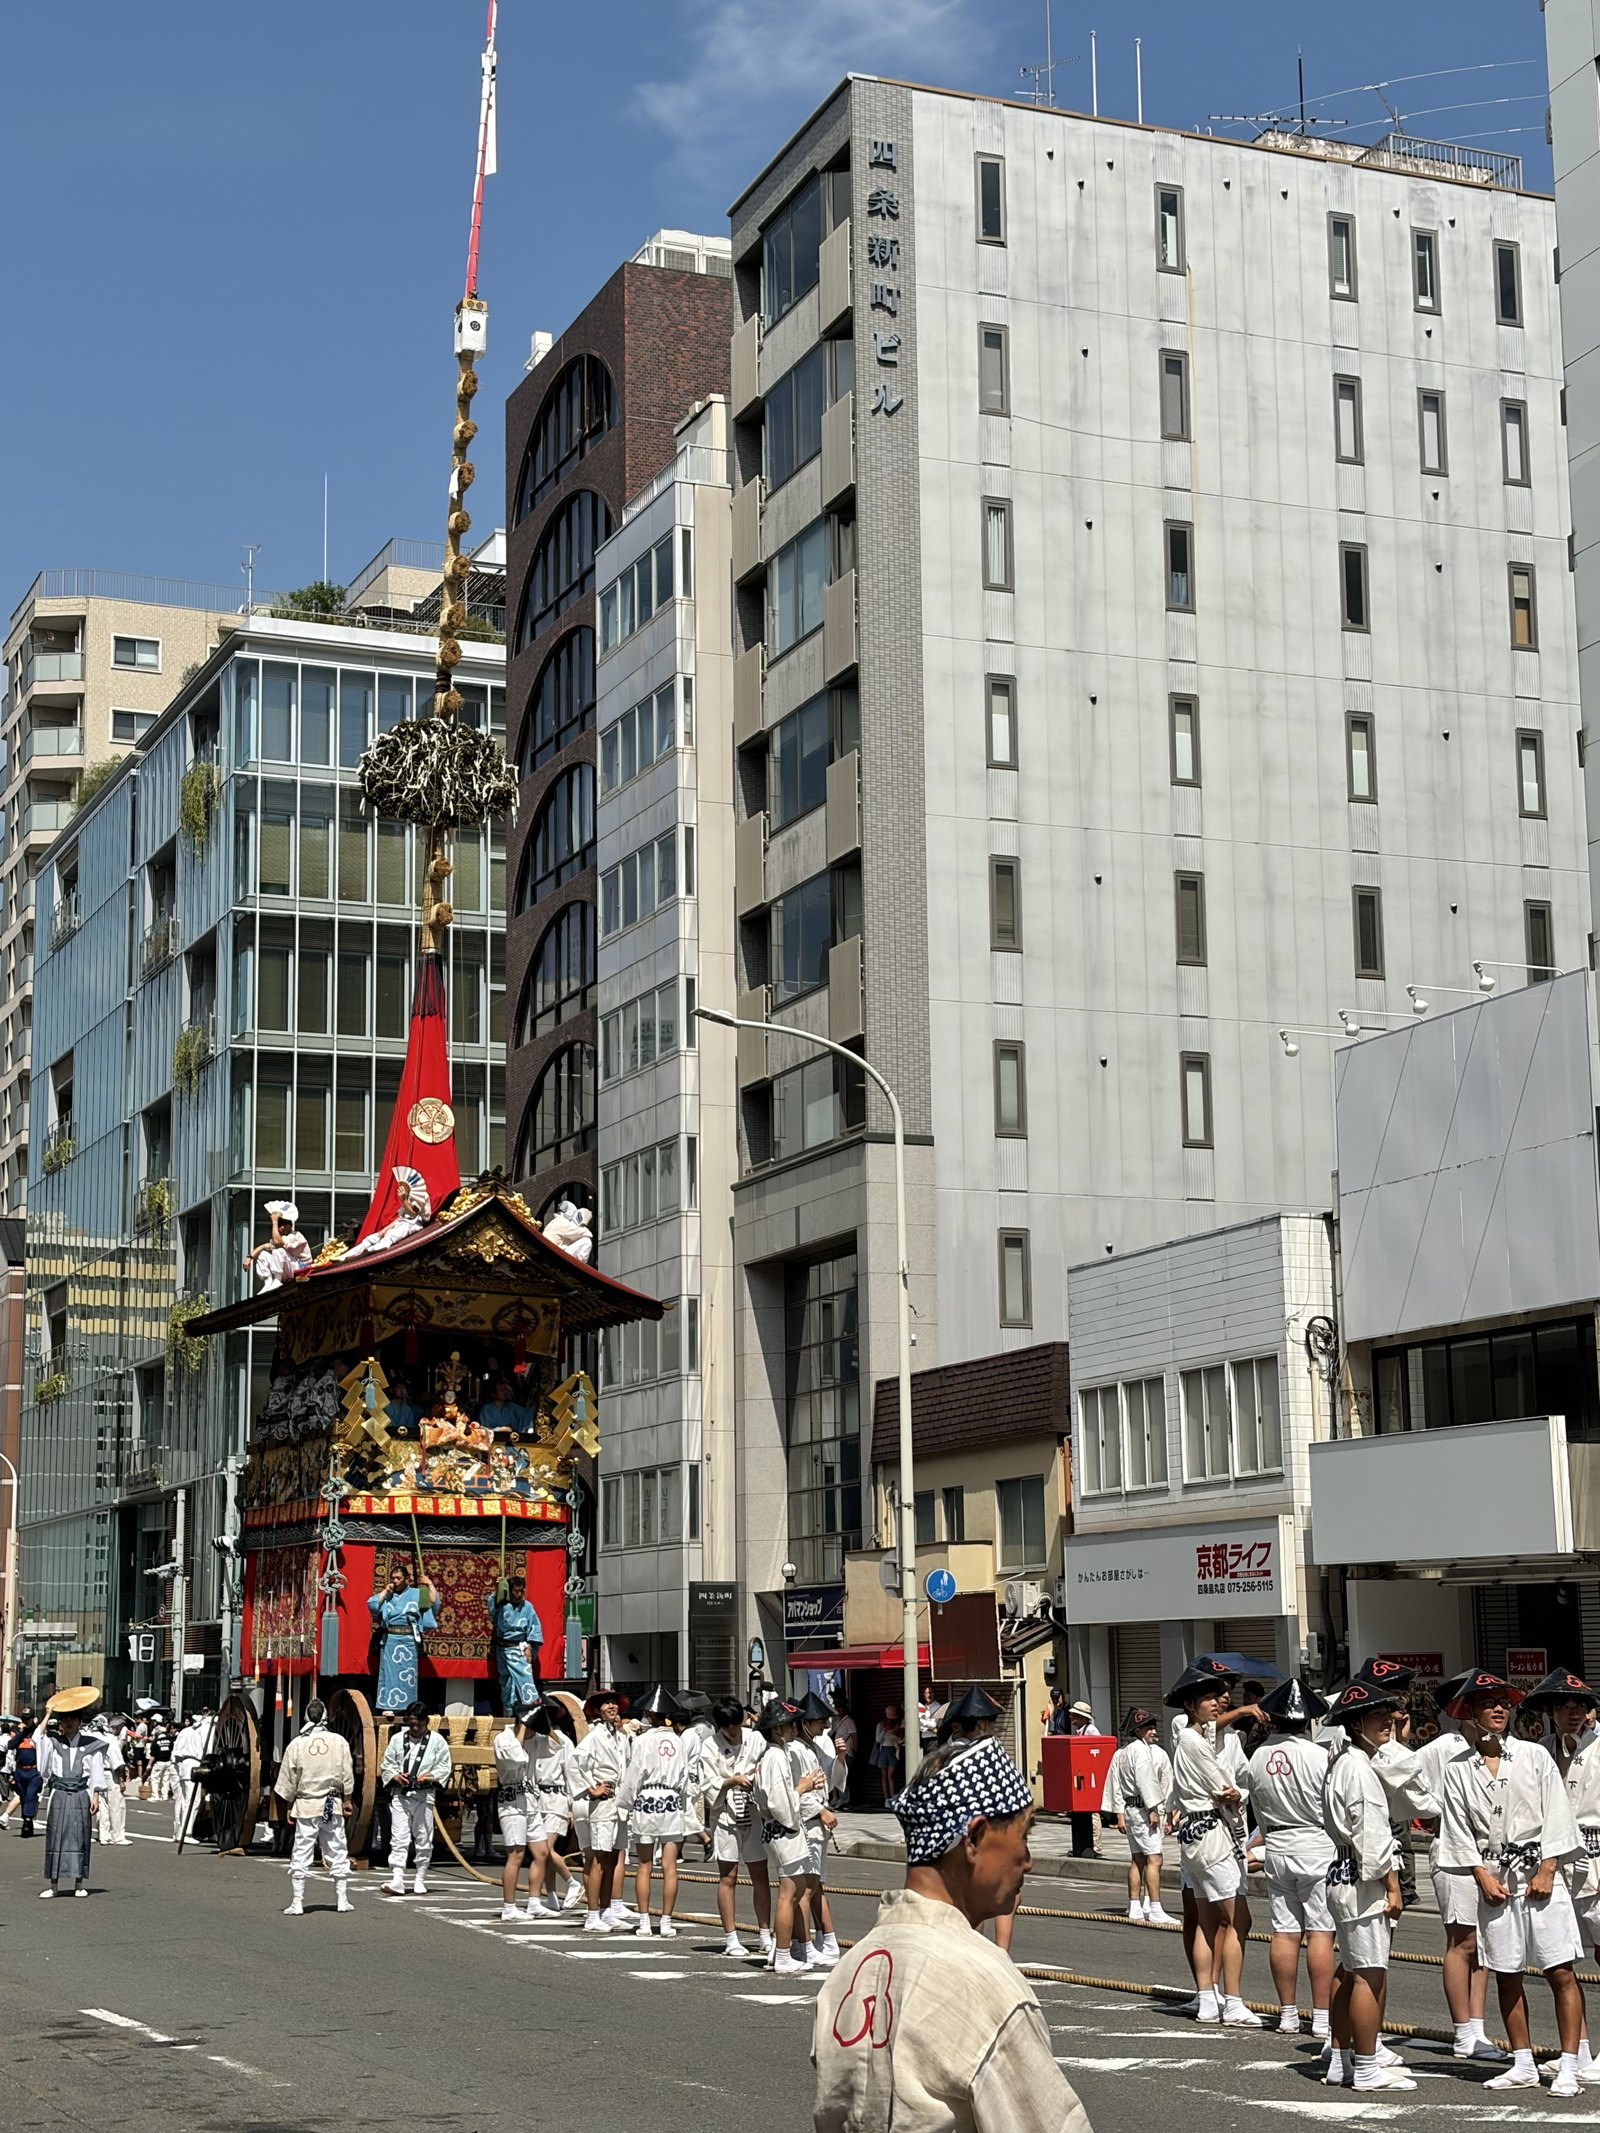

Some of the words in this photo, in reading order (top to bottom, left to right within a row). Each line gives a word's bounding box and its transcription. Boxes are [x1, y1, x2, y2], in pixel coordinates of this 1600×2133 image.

[869, 139, 903, 417] 四条新町ビル
[1196, 1541, 1272, 1580] 京都ライフ
[1197, 1583, 1225, 1595] 四条烏丸店
[1227, 1580, 1274, 1594] 075-256-5115
